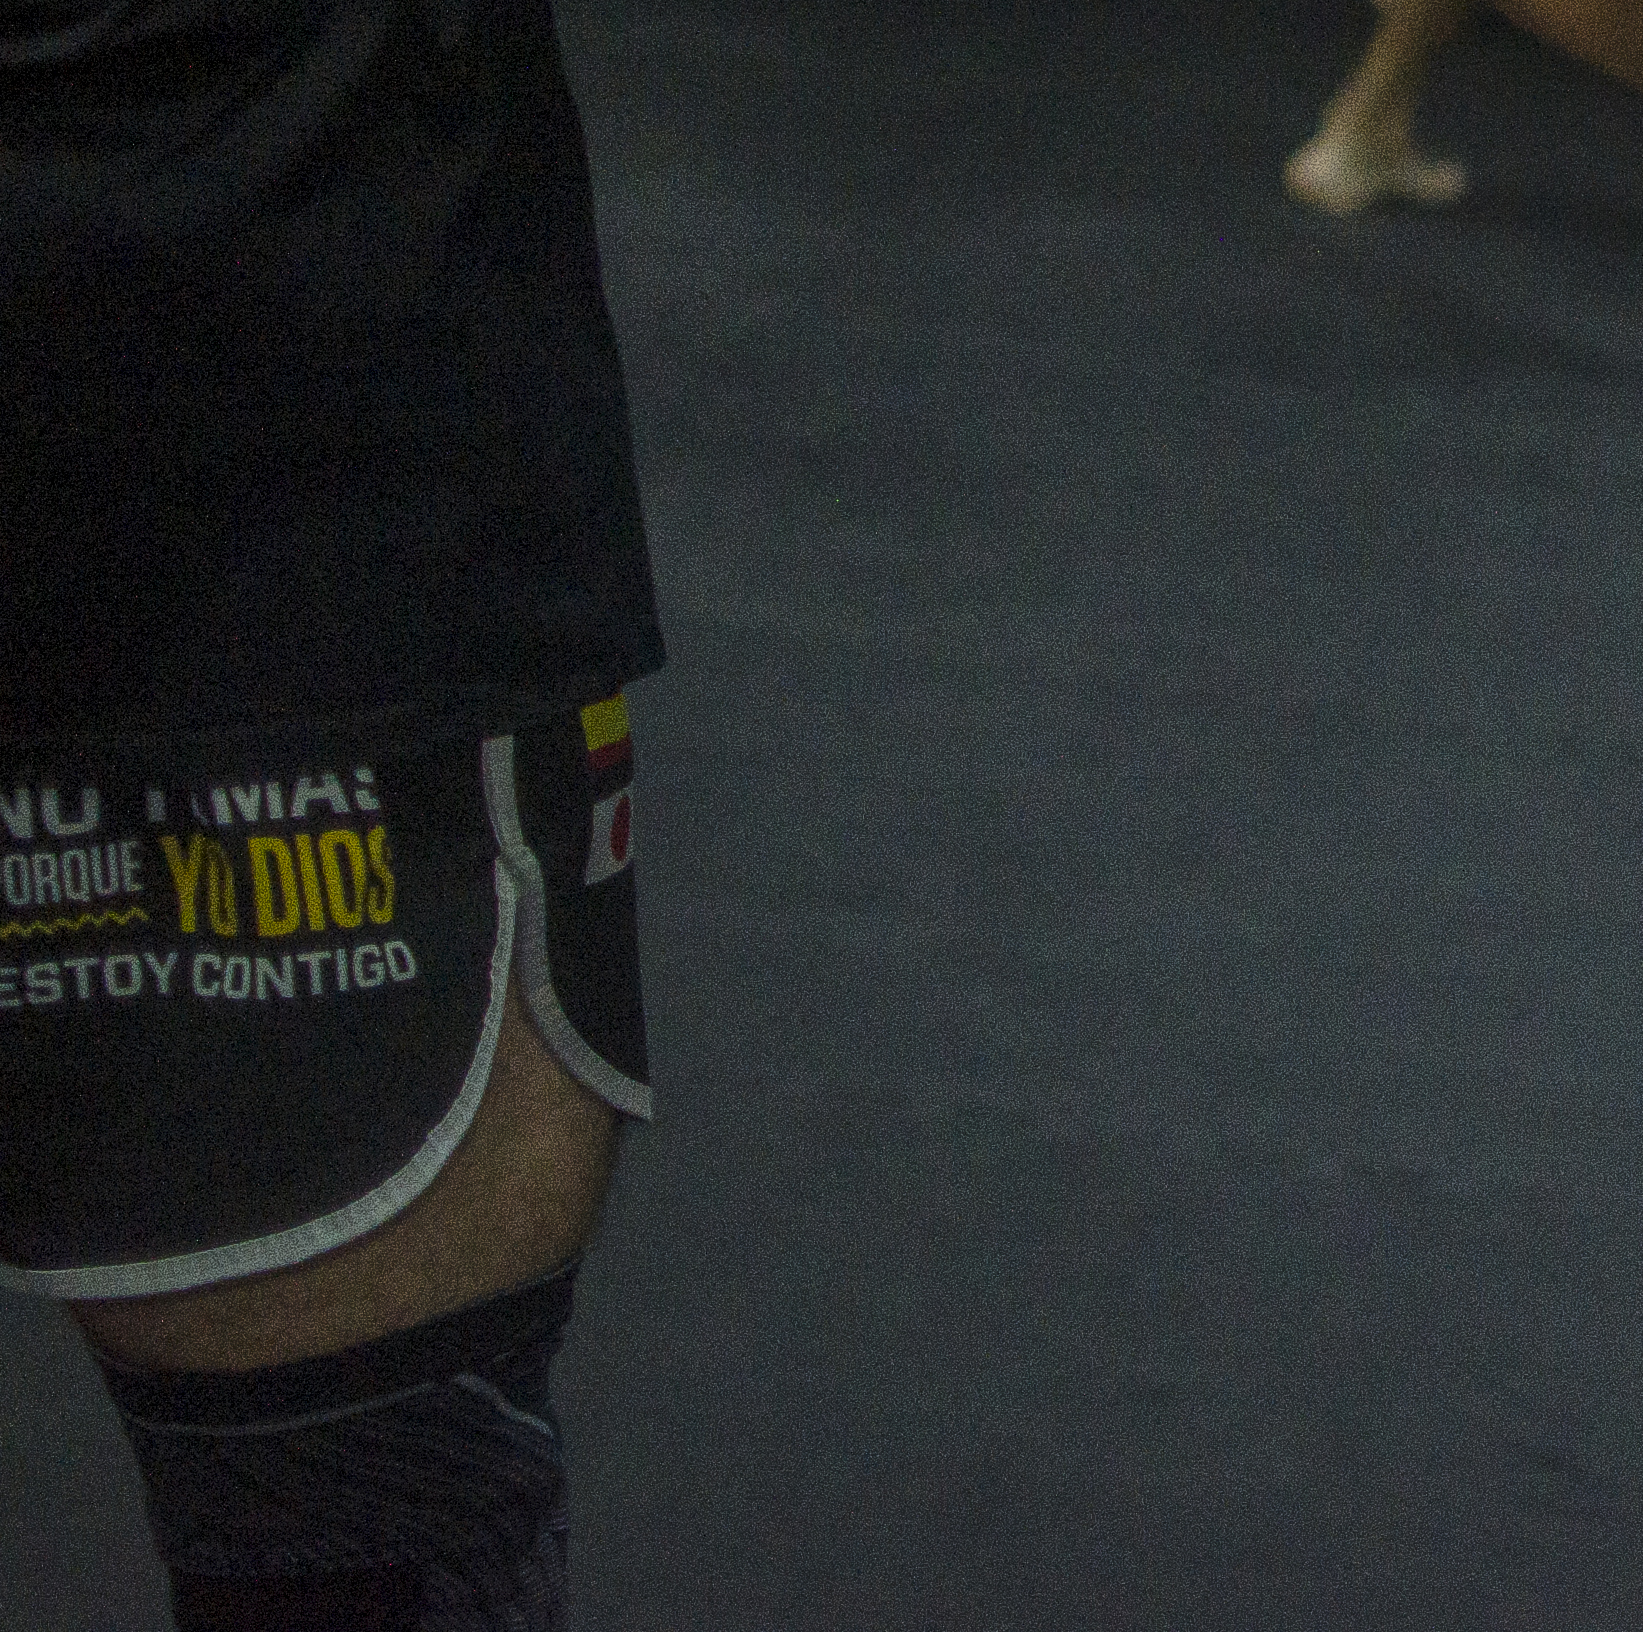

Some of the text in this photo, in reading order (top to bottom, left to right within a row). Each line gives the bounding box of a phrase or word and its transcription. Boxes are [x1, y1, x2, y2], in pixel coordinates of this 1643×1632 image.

[2, 840, 143, 906] ORQUE
[248, 825, 395, 937] DIOS
[0, 940, 418, 1008] ESTOY CONTIGO
